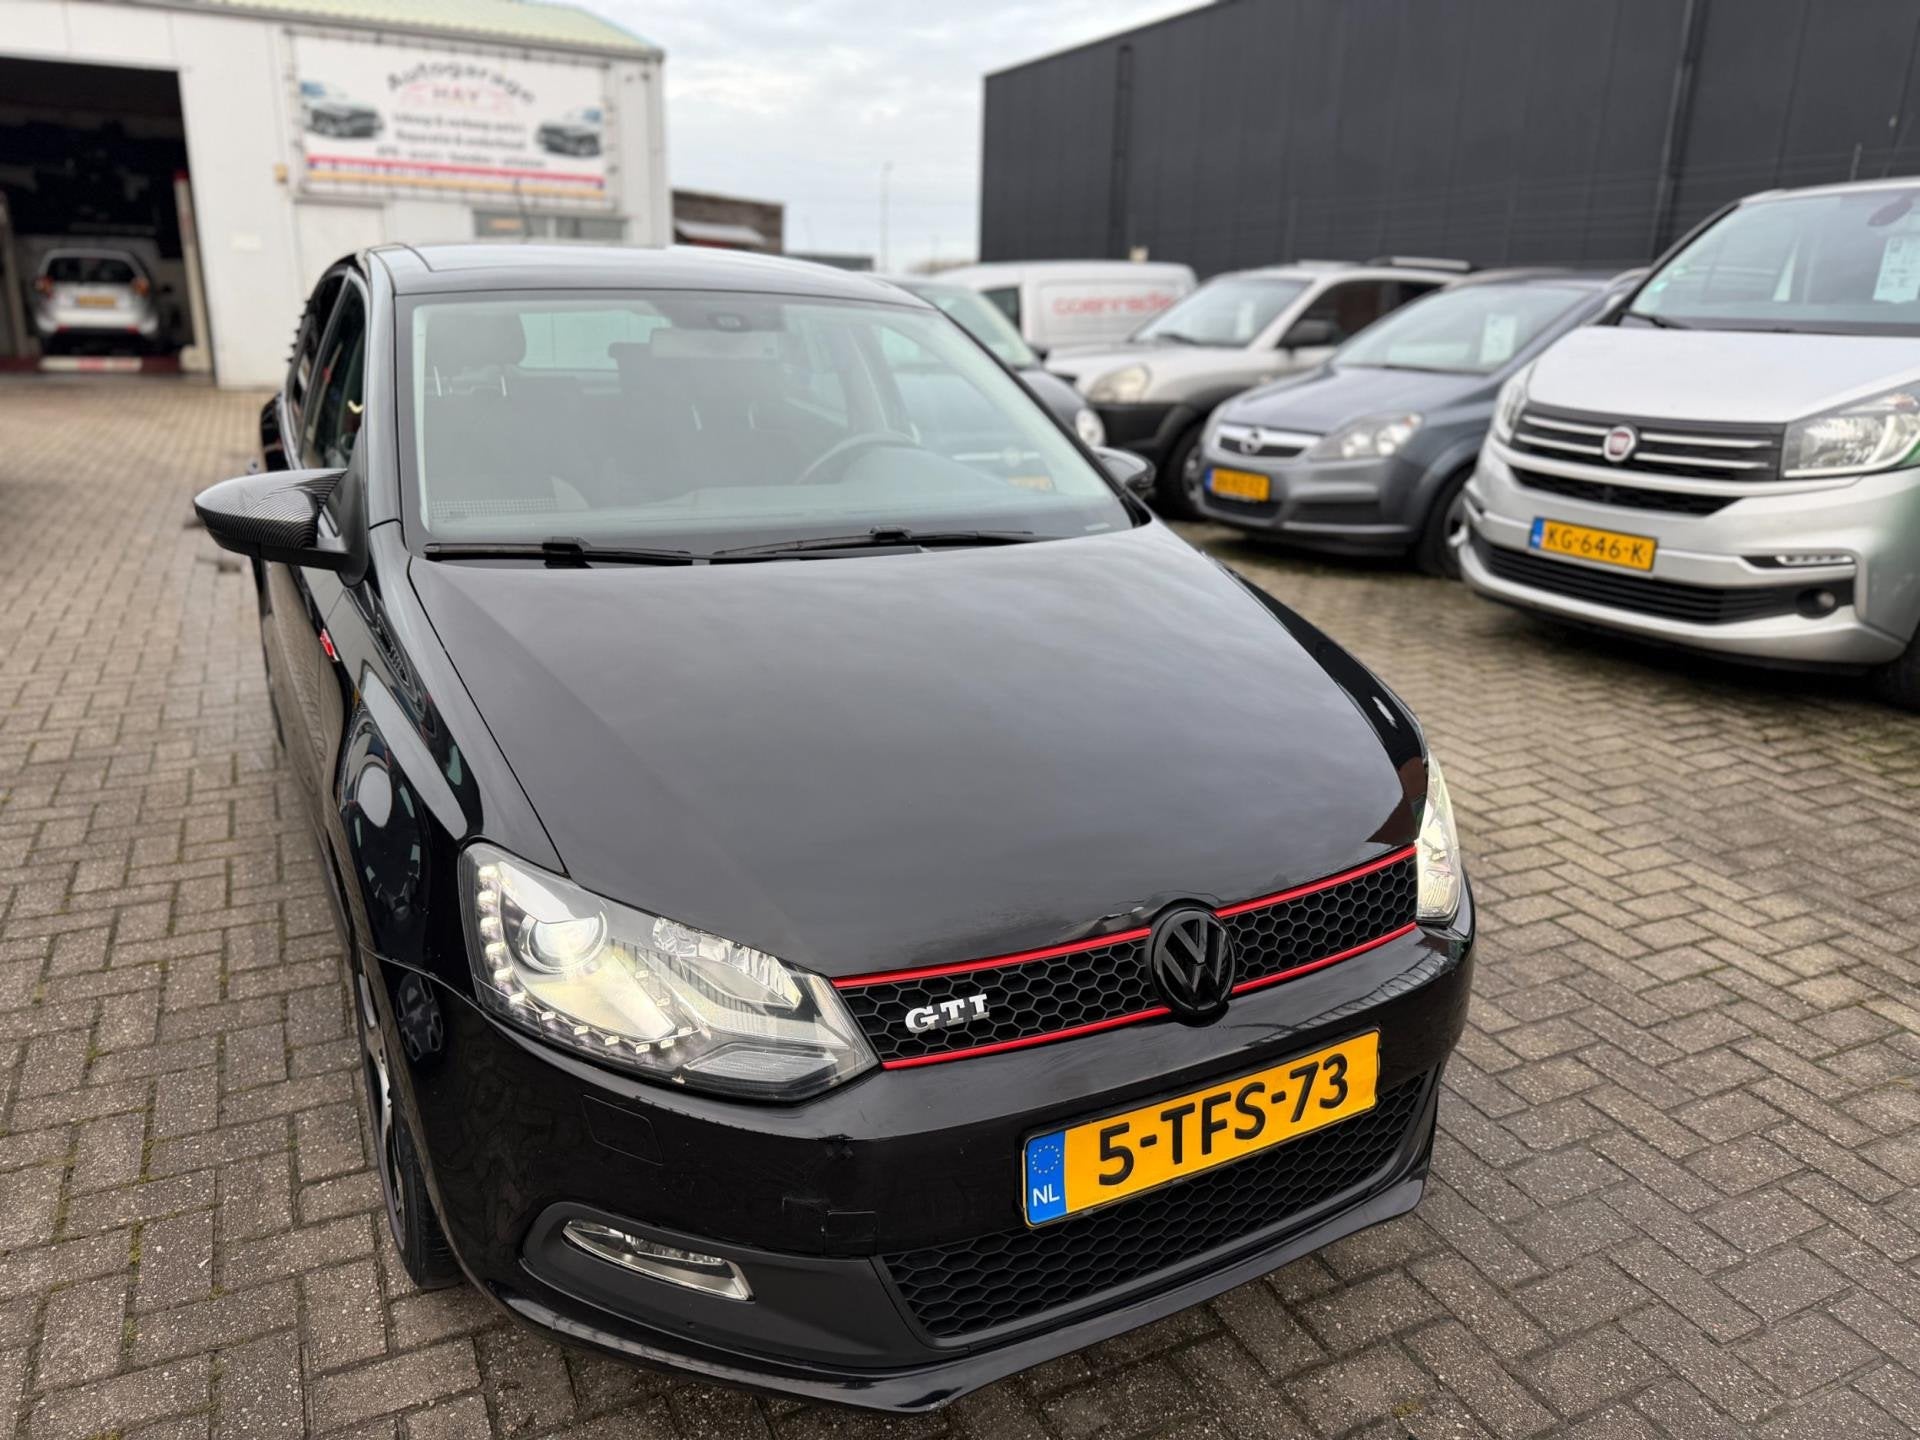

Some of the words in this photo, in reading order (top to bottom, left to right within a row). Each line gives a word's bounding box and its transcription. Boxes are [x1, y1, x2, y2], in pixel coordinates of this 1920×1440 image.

[1546, 525, 1642, 564] KG-646-K
[905, 994, 989, 1033] GTI
[1098, 1053, 1348, 1186] 5-TFS-73
[1032, 1184, 1060, 1206] NL
